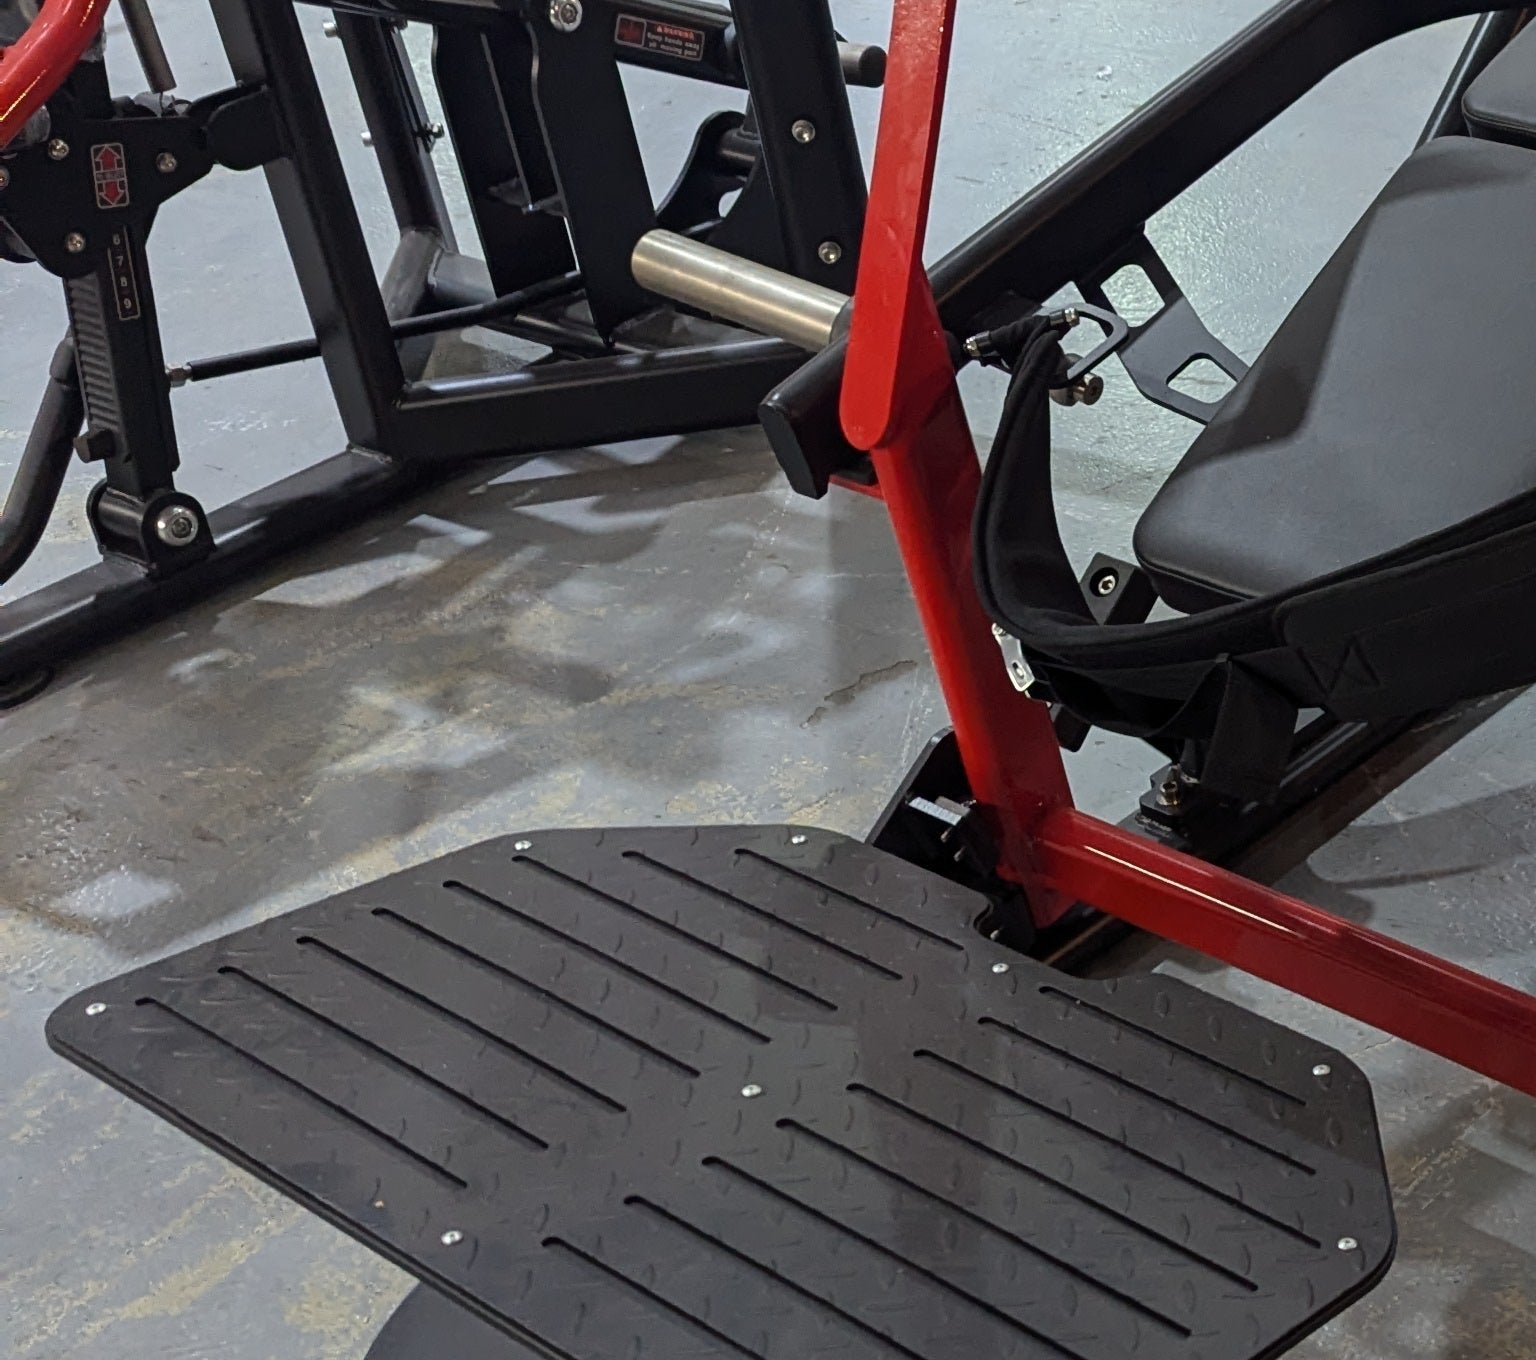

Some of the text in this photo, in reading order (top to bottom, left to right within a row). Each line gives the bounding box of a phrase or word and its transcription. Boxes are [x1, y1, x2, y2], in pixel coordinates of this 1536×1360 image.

[115, 255, 124, 266] 7
[120, 276, 128, 287] 8
[123, 297, 132, 309] 9
